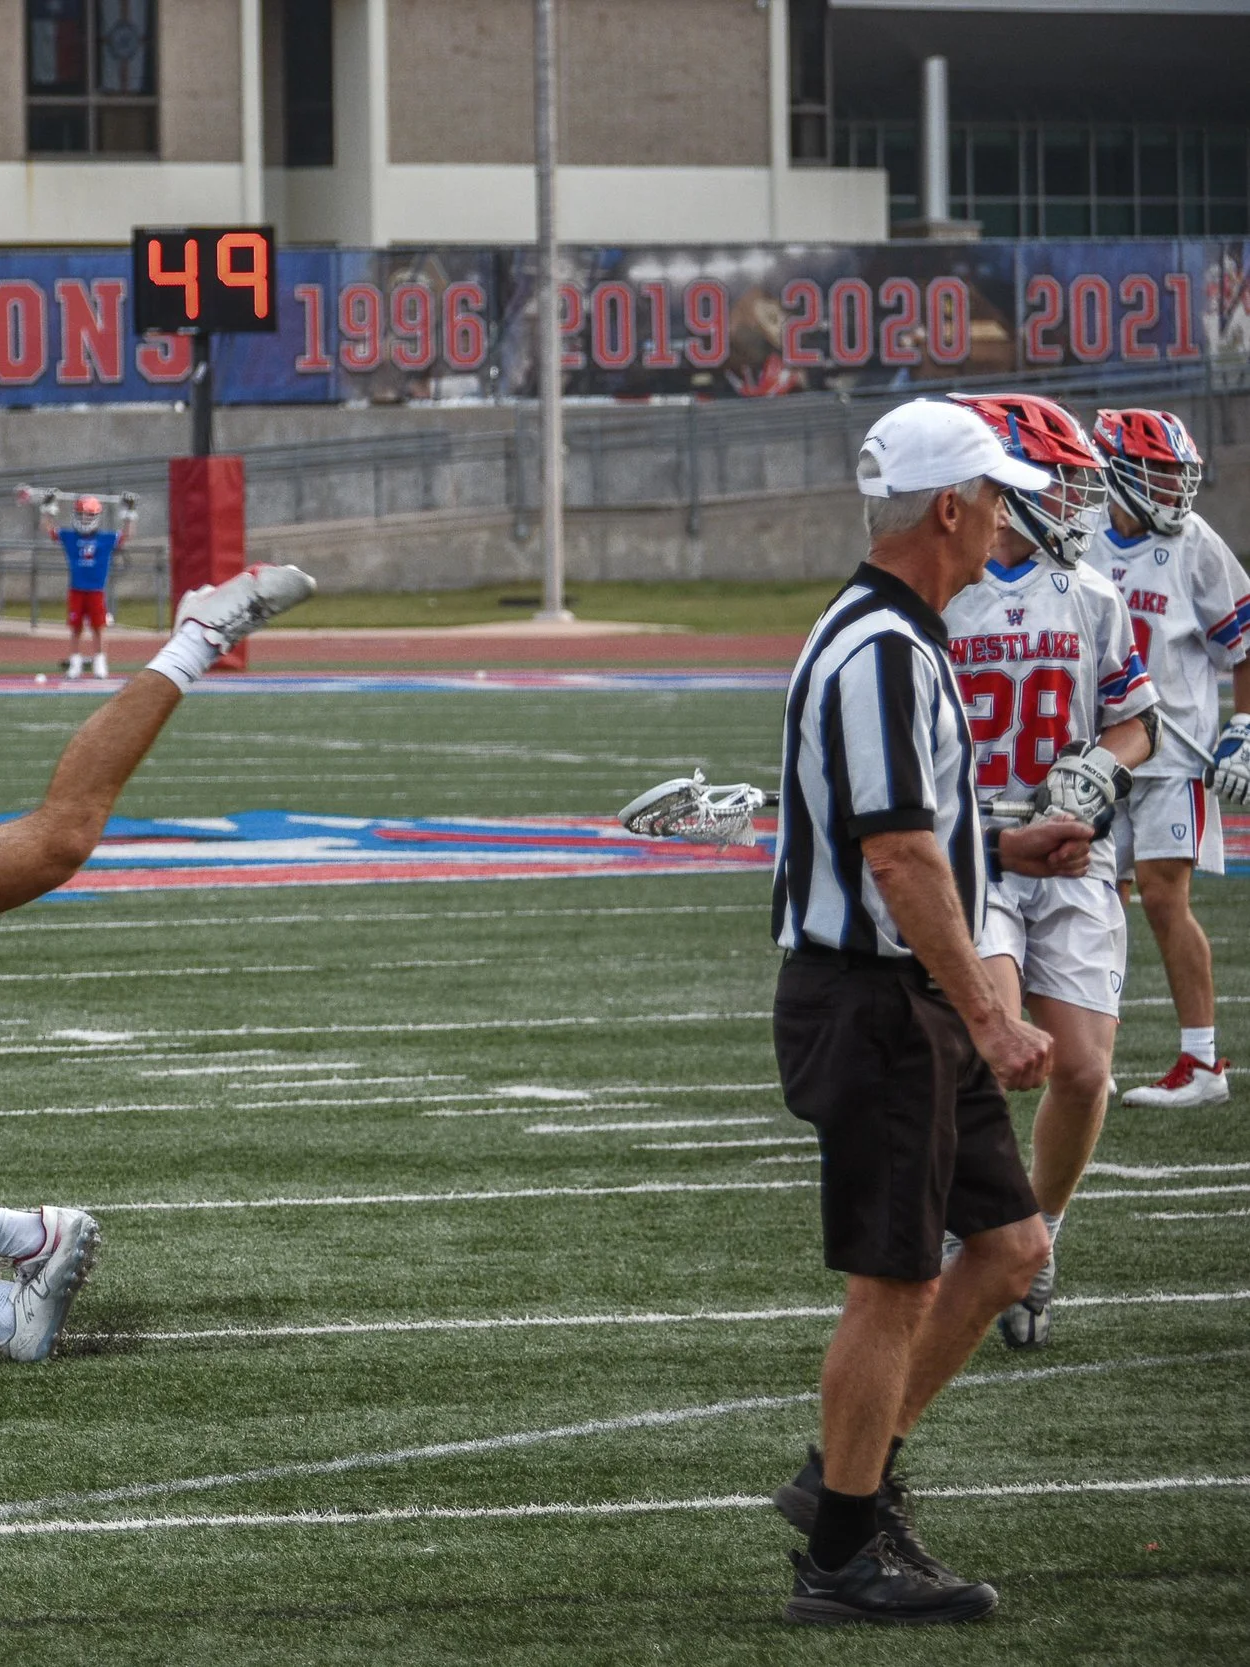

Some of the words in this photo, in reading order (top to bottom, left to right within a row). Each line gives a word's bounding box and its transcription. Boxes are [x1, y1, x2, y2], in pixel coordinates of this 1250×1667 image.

[148, 233, 268, 319] 49
[294, 281, 487, 373] 1996
[556, 279, 730, 370] 2019
[781, 276, 971, 367] 2020
[1025, 272, 1201, 362] 2021
[948, 630, 1081, 666] WESTLAKE
[956, 666, 1077, 790] 28
